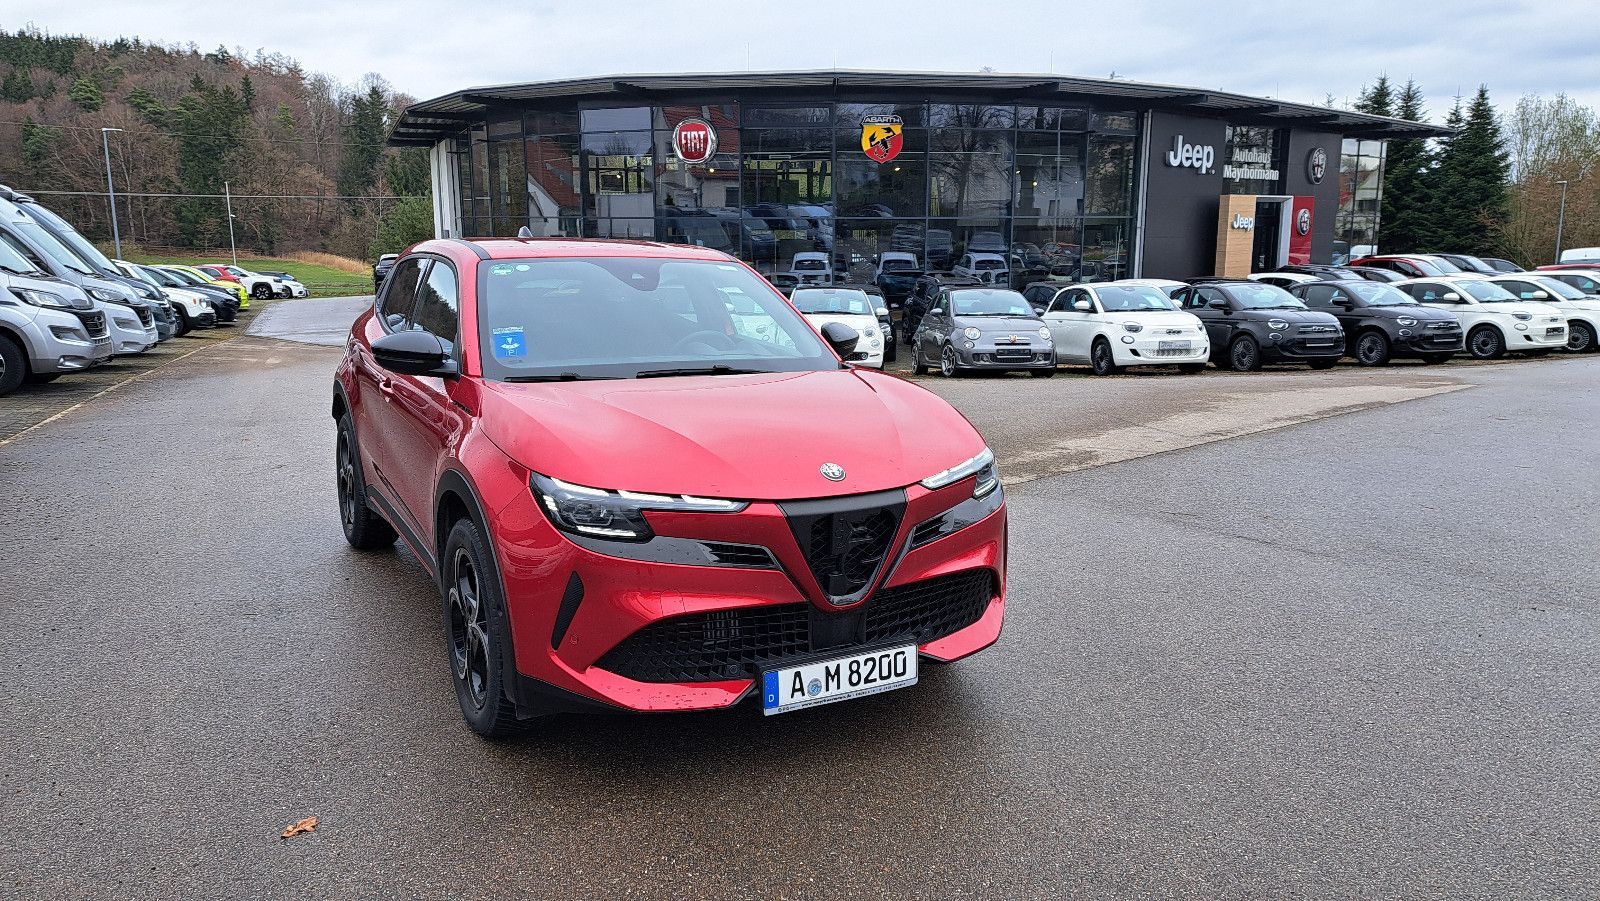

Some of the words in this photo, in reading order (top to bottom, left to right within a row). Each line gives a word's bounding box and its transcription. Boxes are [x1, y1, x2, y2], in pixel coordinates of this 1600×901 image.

[681, 130, 706, 152] FIAT
[1169, 134, 1215, 174] Jeep
[1233, 147, 1272, 164] Autohaus
[1233, 214, 1254, 231] Jeep
[791, 671, 806, 699] A
[825, 663, 841, 692] M
[848, 650, 907, 687] 8200
